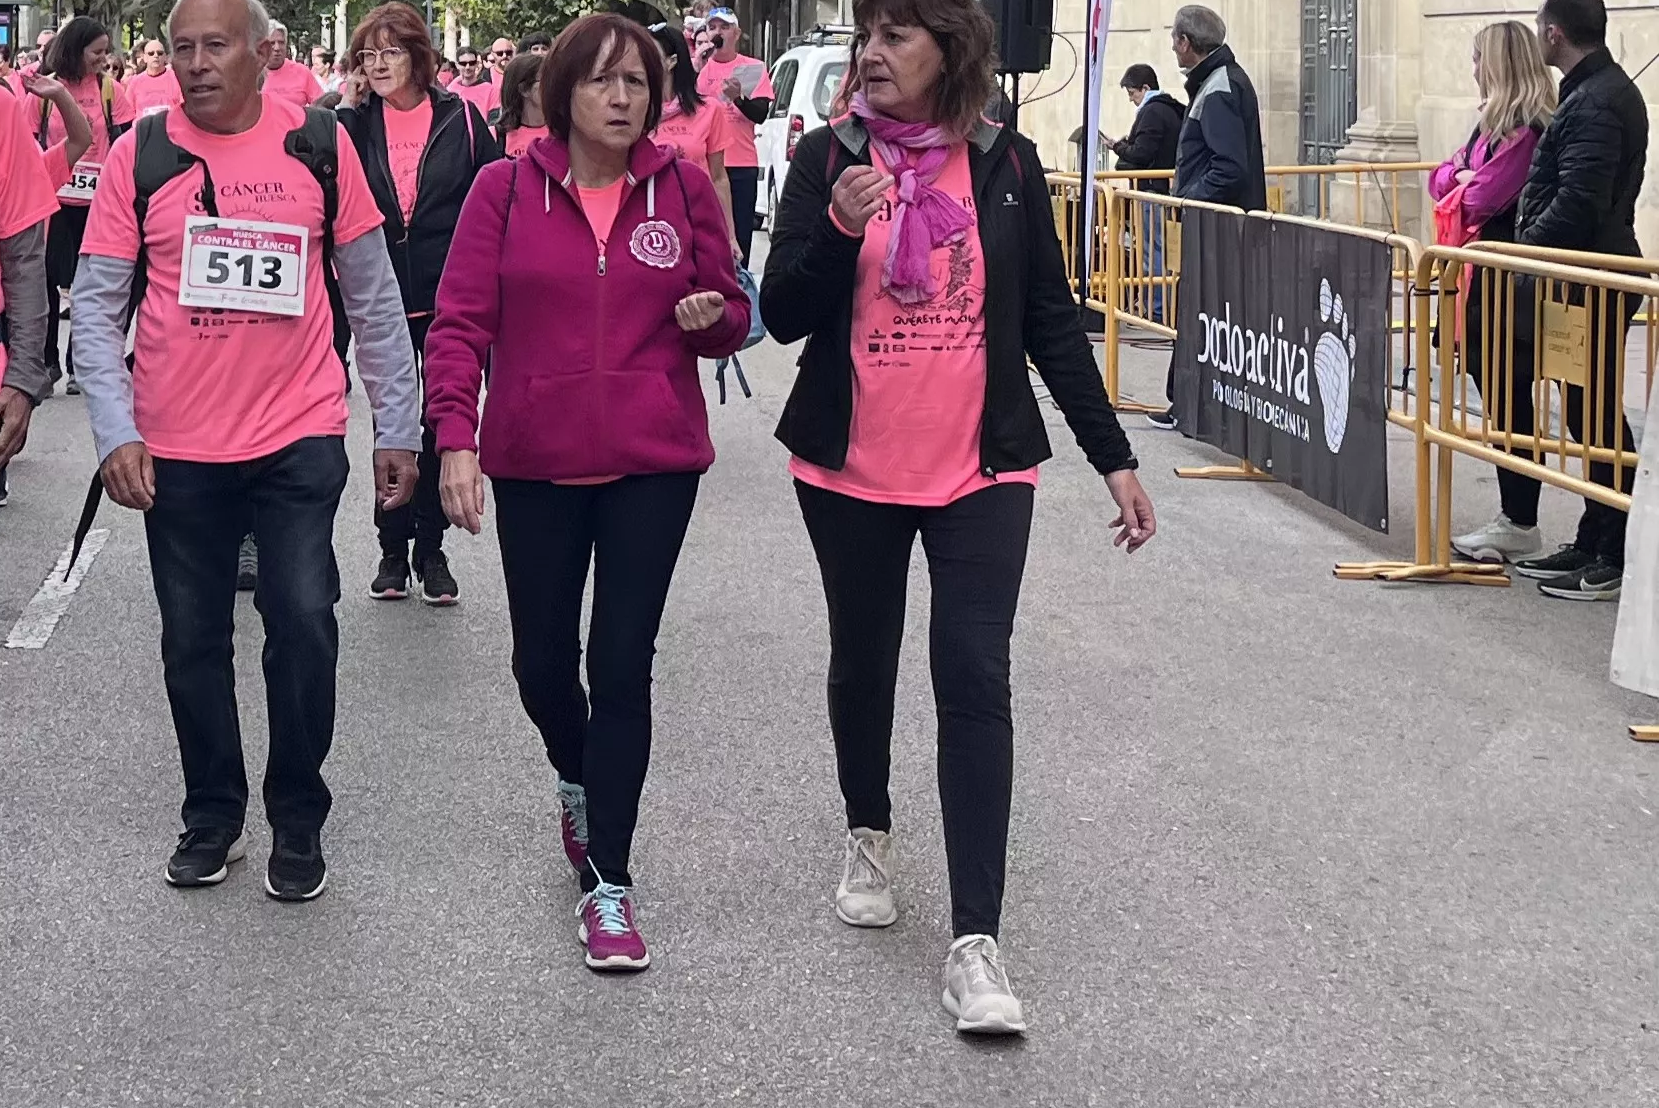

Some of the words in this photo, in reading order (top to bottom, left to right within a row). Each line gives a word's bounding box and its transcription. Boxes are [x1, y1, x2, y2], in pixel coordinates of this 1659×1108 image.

[220, 181, 284, 198] CÁNCER
[255, 194, 297, 204] HUESCA
[197, 234, 240, 247] CONTRA
[242, 238, 254, 248] EL
[255, 240, 296, 252] CÁNCER
[233, 230, 263, 240] HUESCA
[206, 251, 282, 289] 513
